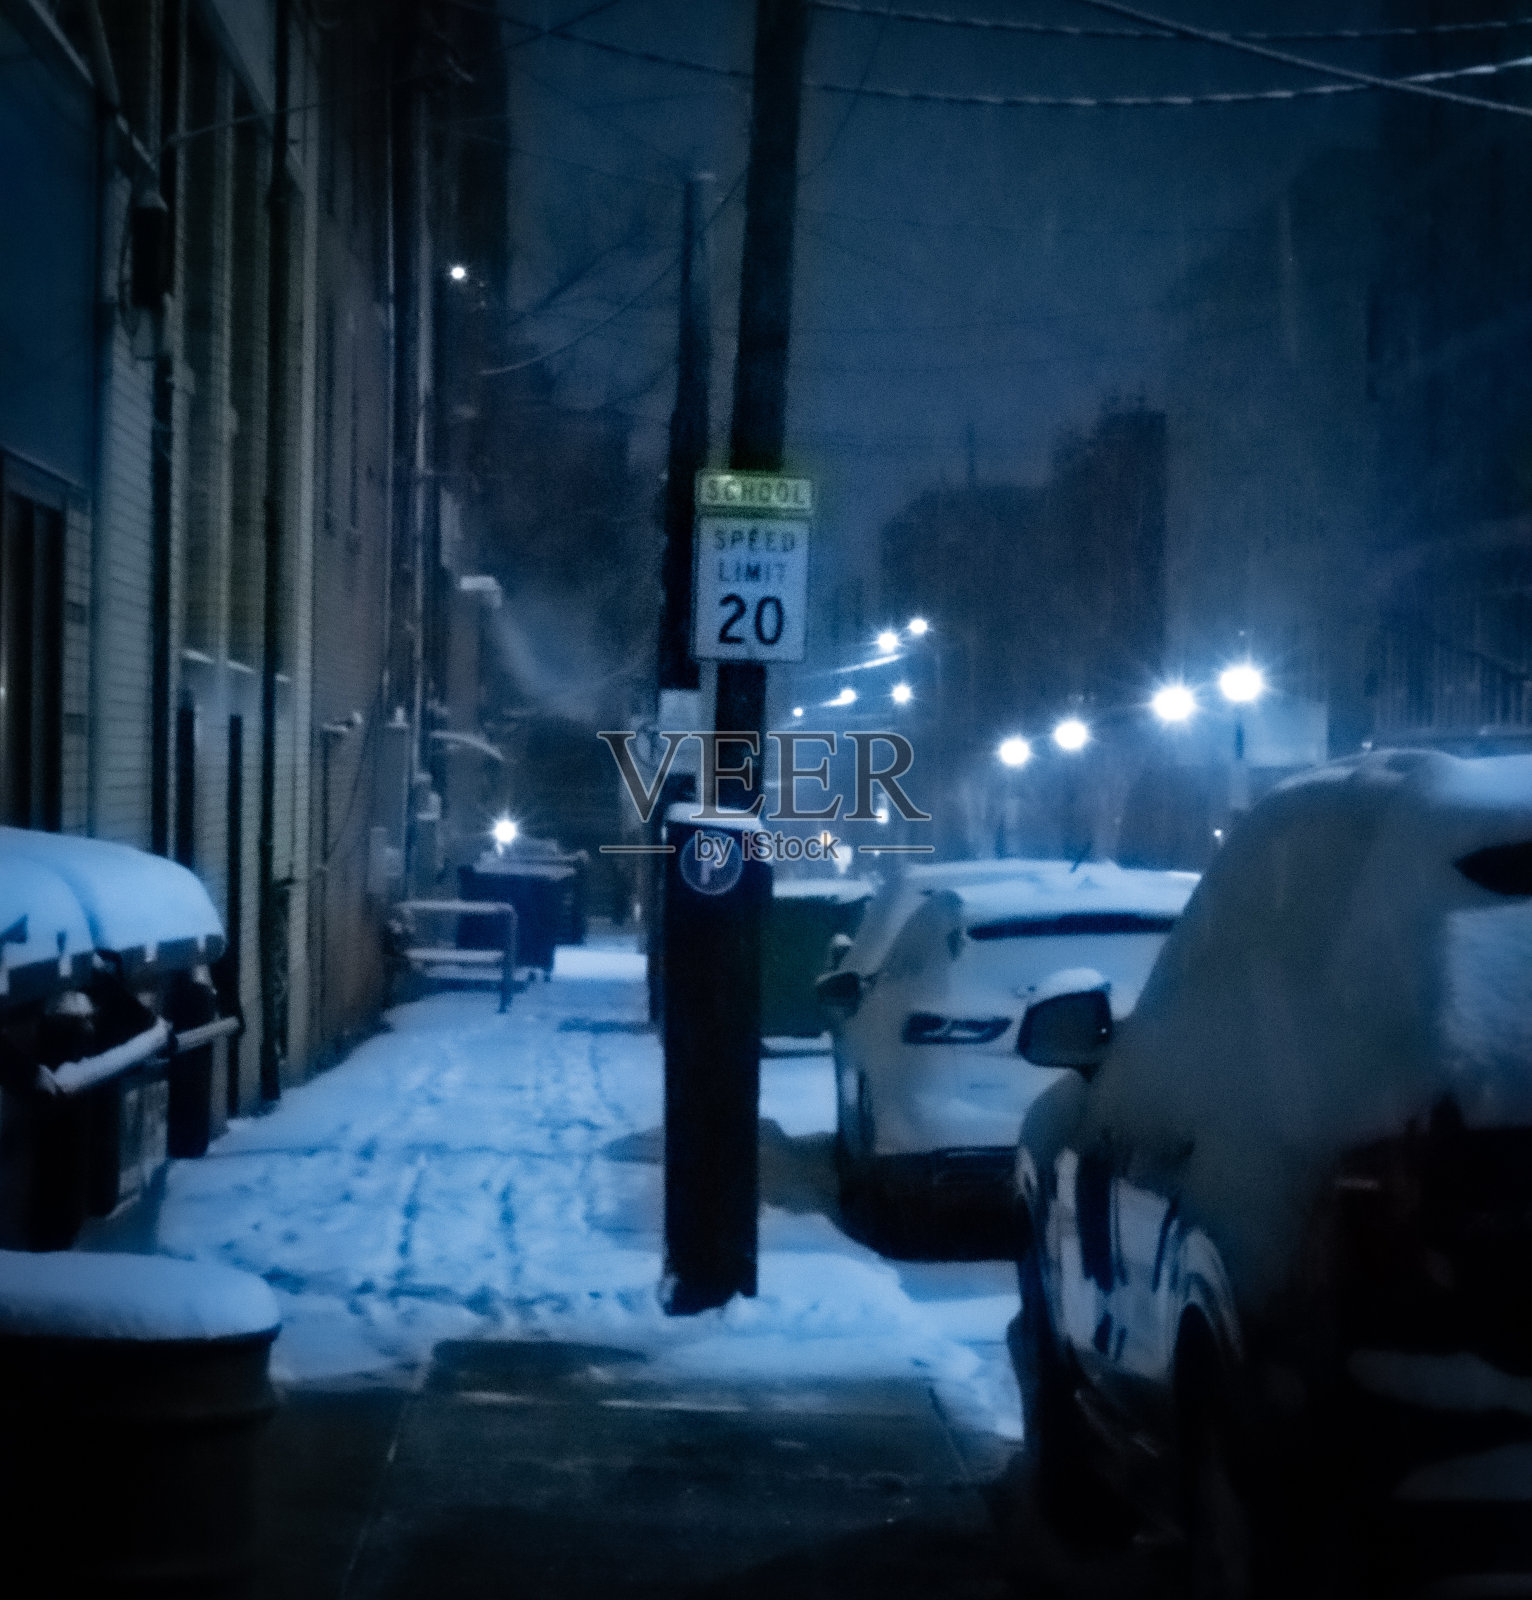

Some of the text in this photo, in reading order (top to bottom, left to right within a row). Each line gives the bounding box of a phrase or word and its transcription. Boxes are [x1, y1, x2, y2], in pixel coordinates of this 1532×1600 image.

[706, 479, 807, 504] SCHOOL
[713, 529, 796, 553] SPEED
[717, 559, 787, 584] LIMIT
[718, 593, 785, 646] 20
